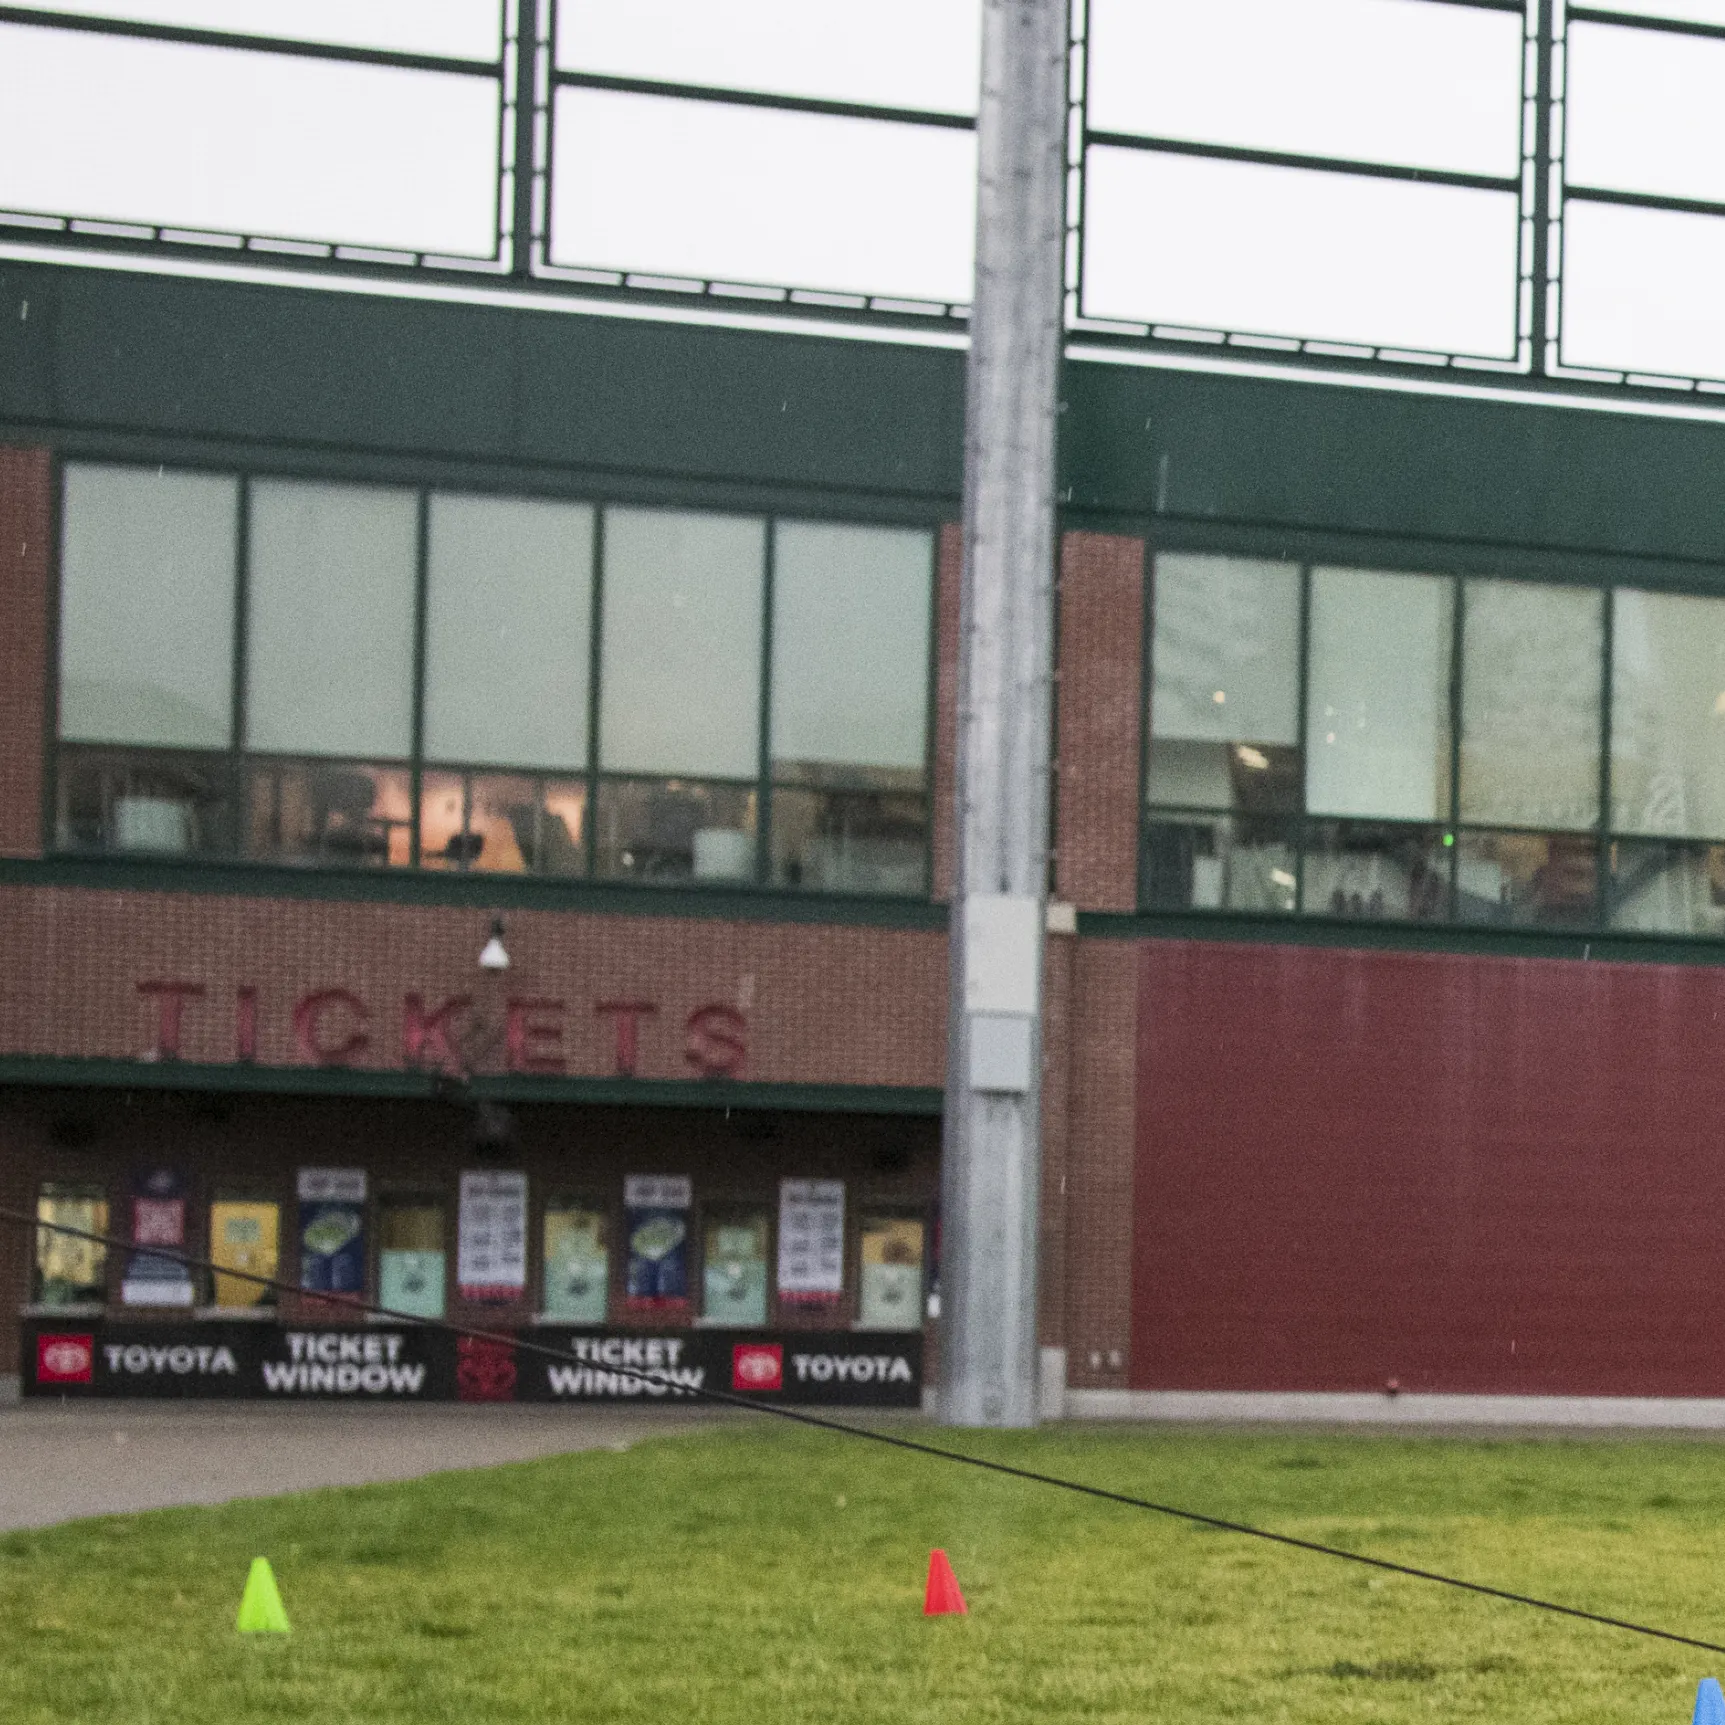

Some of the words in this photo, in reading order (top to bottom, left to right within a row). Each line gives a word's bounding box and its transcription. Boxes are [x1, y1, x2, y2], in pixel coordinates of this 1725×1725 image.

[137, 978, 752, 1081] TICKETS
[104, 1344, 238, 1375] TOYOTA
[286, 1332, 403, 1362] TICKET
[571, 1338, 685, 1366] TICKET
[263, 1362, 427, 1393] WINDOW
[547, 1365, 706, 1397] WINDOW
[793, 1353, 914, 1382] TOYOTA
